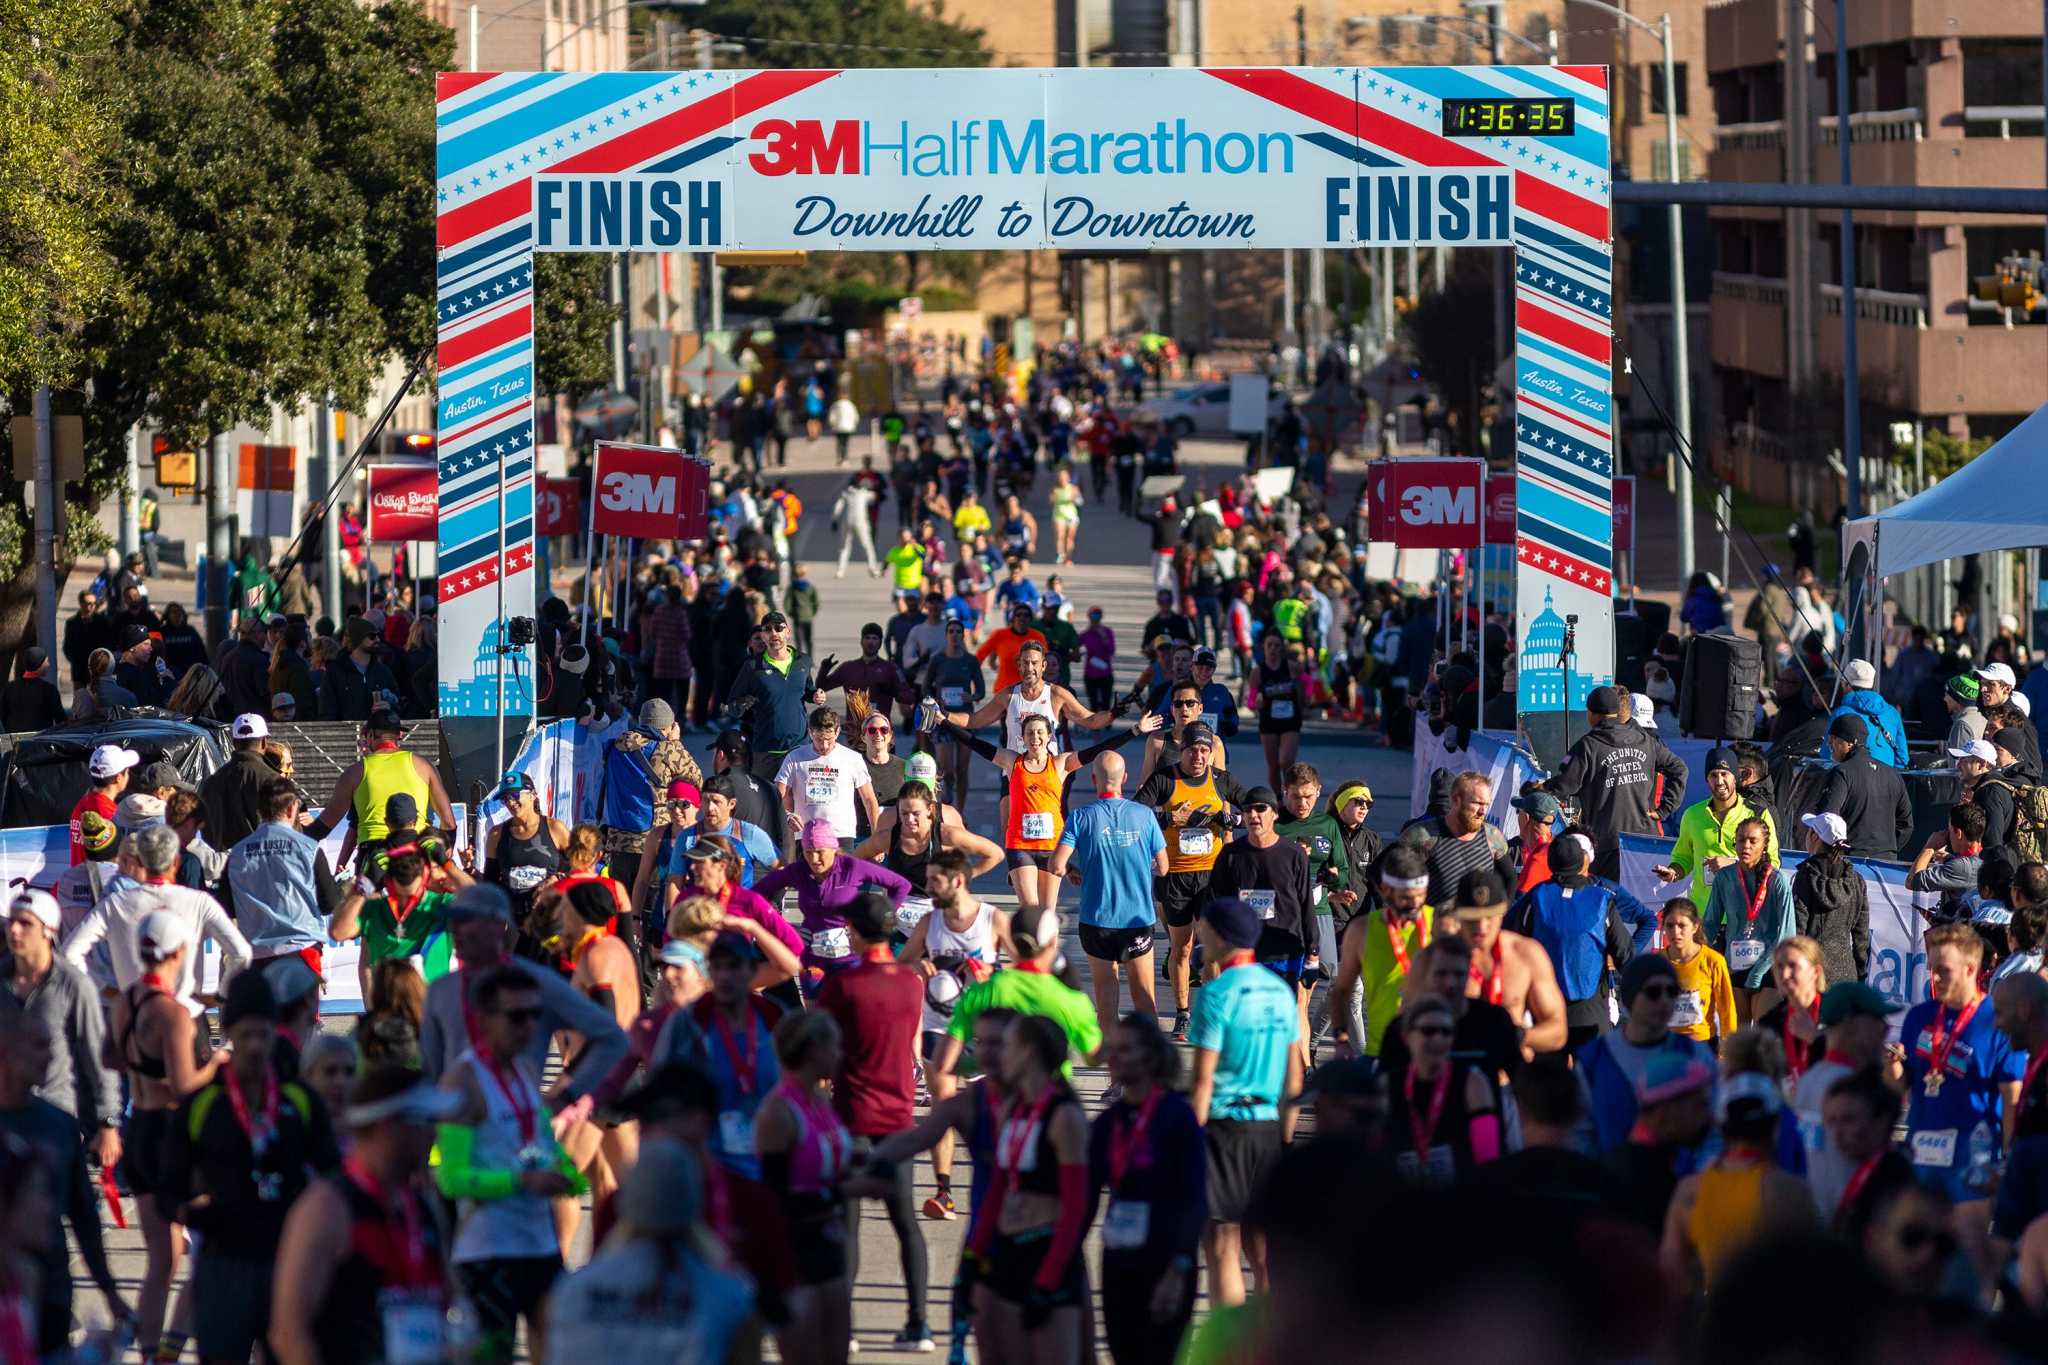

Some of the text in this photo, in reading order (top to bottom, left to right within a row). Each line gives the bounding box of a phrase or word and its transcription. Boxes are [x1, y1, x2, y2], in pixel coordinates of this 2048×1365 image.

[748, 116, 1295, 177] 3M Half Marathon
[538, 180, 722, 247] FINISH
[793, 193, 1257, 239] Downhill to Downtown
[1326, 174, 1511, 242] FINISH
[444, 377, 525, 420] Austin, Texas
[1522, 370, 1606, 412] Austin, Texas
[600, 471, 677, 515] 3M
[1400, 485, 1476, 526] 3M
[1601, 747, 1647, 767] THE UNITED
[1612, 761, 1641, 774] STATES
[1605, 772, 1648, 788] OF AMERICA
